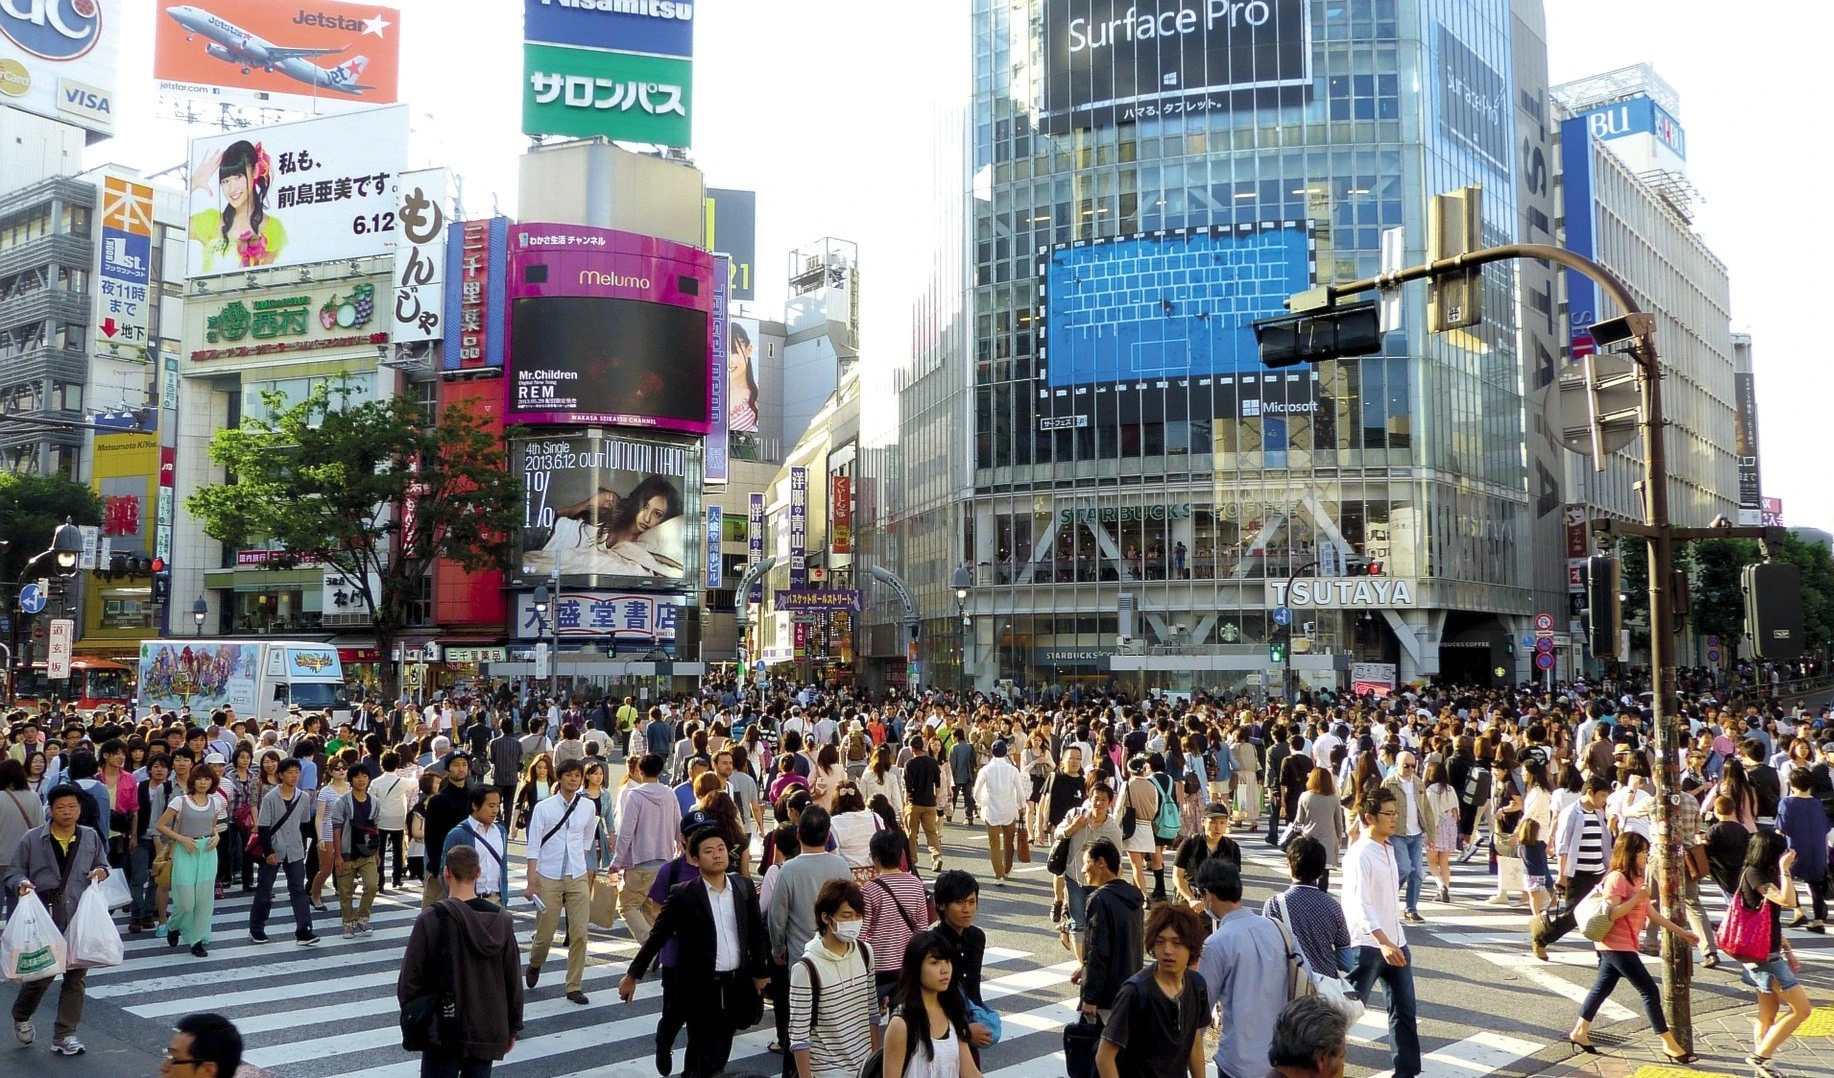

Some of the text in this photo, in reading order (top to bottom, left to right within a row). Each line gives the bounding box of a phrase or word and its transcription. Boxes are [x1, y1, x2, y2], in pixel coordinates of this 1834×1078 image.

[208, 16, 243, 39] Jetstar
[292, 10, 365, 32] Jetstar
[1069, 0, 1269, 52] Surface Pro
[160, 81, 209, 95] jetstar.com
[530, 71, 686, 116] サロンパス
[65, 88, 111, 114] VISA
[278, 150, 322, 175] 私も、
[277, 172, 398, 209] 前島亜美です。
[353, 212, 395, 235] 6.12
[529, 236, 606, 246] わかさ生活 チャンネル
[395, 187, 443, 336] もんじゃ
[101, 280, 146, 302] 夜11時
[460, 225, 484, 360] 三千里薬品
[110, 299, 137, 317] まで
[121, 322, 145, 341] 地下
[519, 370, 578, 380] Mr.Children
[1263, 400, 1318, 414] Microsoft
[628, 417, 657, 425] CHANNEL
[1044, 418, 1072, 428] サーフェス
[97, 443, 136, 452] Matsumoto
[525, 440, 570, 455] 4th Single
[525, 452, 605, 471] 2013.6.12 OUT
[104, 494, 140, 536] 薬
[791, 471, 805, 548] 洋服の青山
[1060, 502, 1193, 524] STARBUCKS
[709, 511, 720, 582] 大盛堂商事ビル
[239, 553, 266, 563] 国内旅行
[1271, 581, 1411, 606] TSUTAYA
[524, 600, 676, 630] 大盛堂書店
[51, 625, 64, 673] 道玄坂
[450, 650, 501, 661] 三千里薬品
[1046, 651, 1098, 660] STARBUCKS
